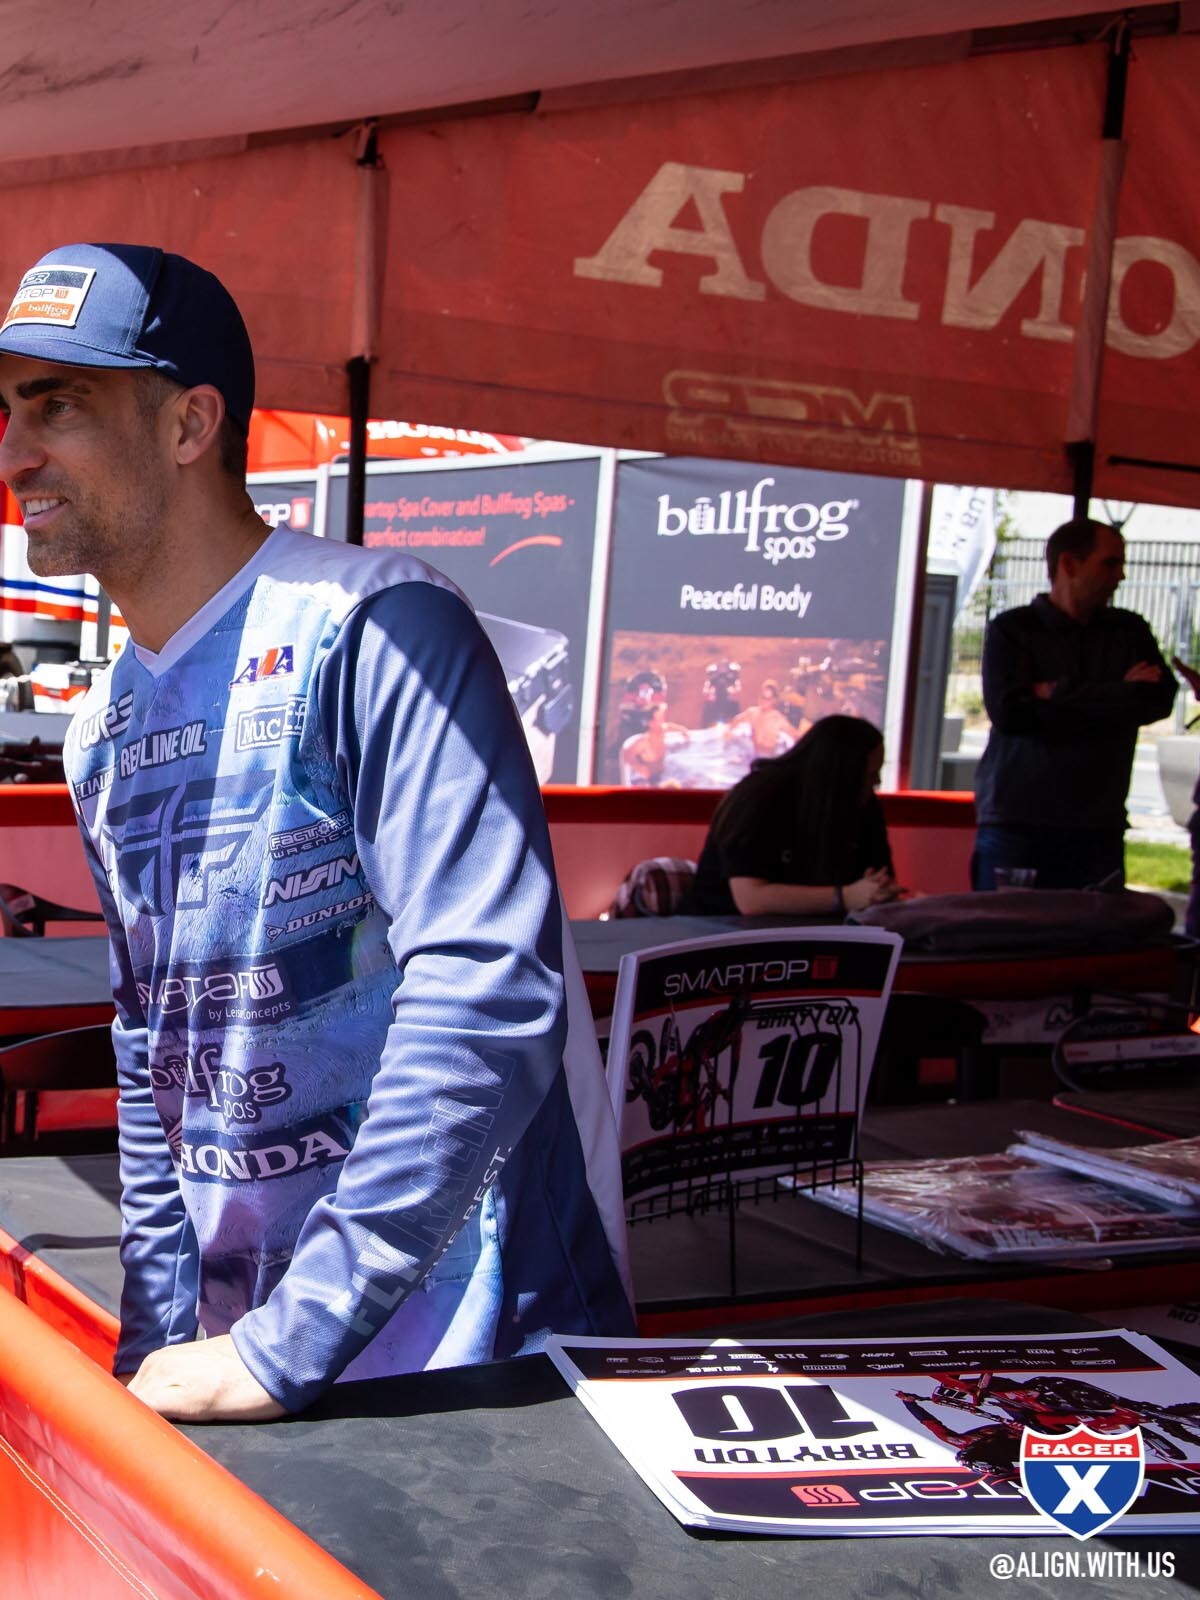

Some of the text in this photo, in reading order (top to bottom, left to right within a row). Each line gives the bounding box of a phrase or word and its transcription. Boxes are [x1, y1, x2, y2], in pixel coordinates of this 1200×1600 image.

[420, 496, 454, 517] Cover
[481, 491, 532, 519] Bullfrog
[533, 488, 567, 517] Spas
[657, 478, 850, 551] bullfrog
[763, 535, 816, 565] spas
[680, 583, 812, 618] Peaceful Body
[180, 722, 205, 757] OIL
[664, 960, 809, 997] SMARTOP
[208, 1008, 222, 1022] by
[753, 1033, 843, 1109] 10
[181, 1130, 350, 1181] HONDA
[671, 1384, 879, 1443] 10
[693, 1443, 926, 1465] BRAYTON
